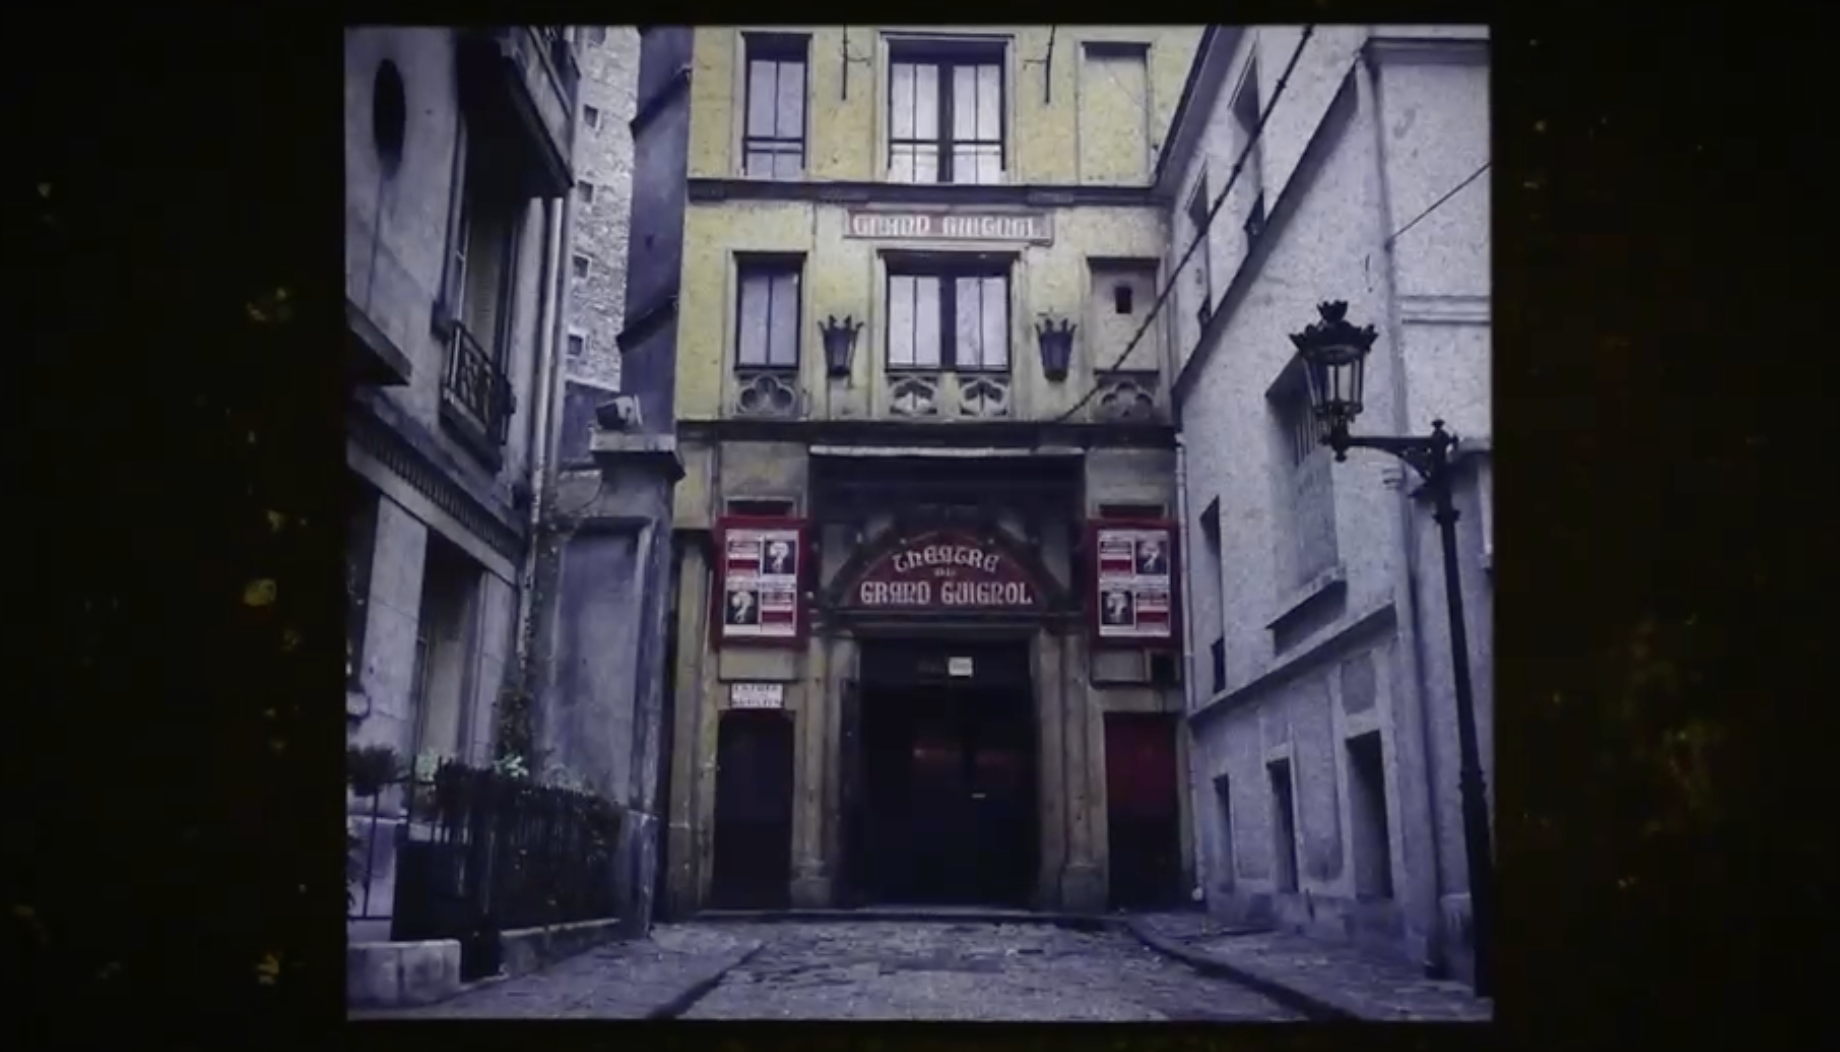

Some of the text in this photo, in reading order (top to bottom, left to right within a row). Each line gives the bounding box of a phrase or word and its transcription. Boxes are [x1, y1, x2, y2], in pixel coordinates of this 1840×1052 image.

[853, 213, 931, 236] GRAND
[860, 581, 1033, 605] GRAND GUIGNOL
